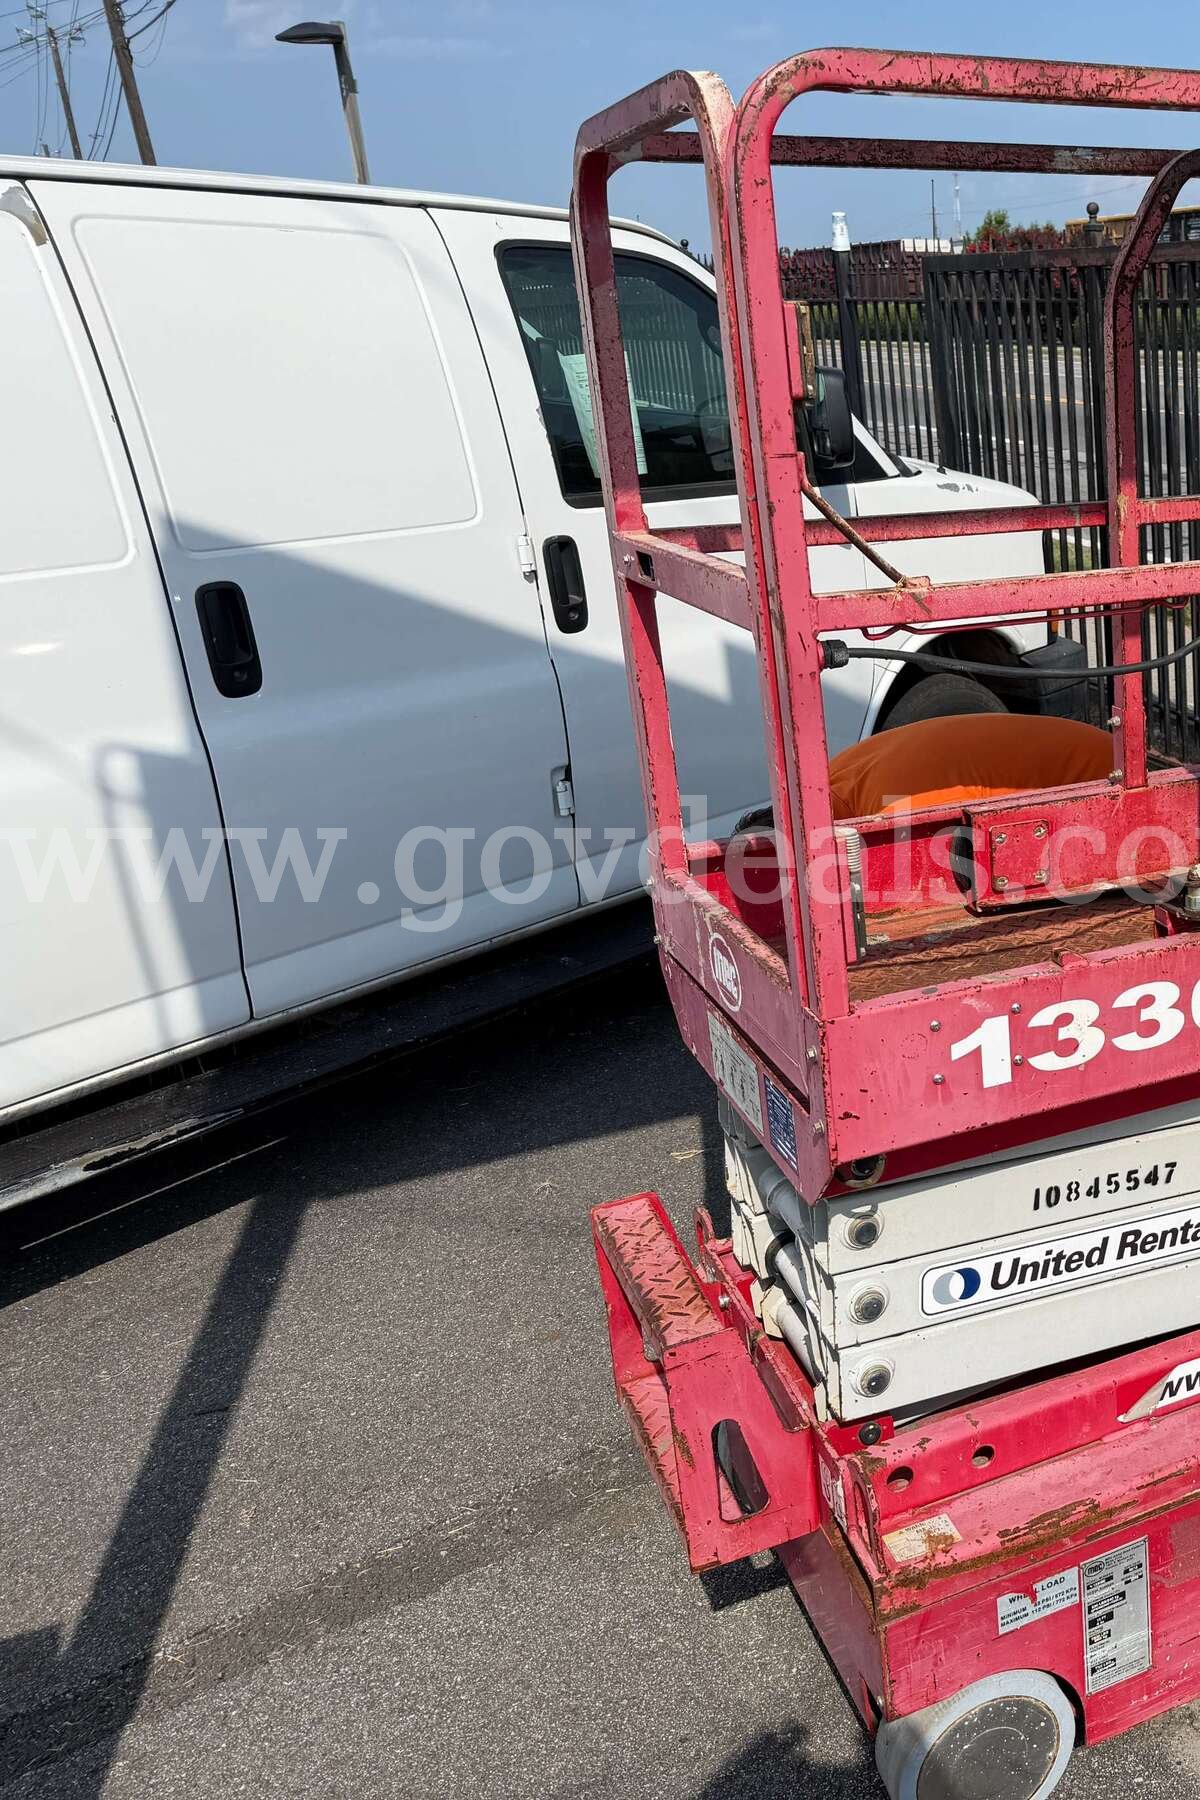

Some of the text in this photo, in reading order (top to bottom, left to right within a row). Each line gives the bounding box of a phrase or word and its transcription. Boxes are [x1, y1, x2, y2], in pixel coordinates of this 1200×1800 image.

[1032, 1161, 1178, 1211] 10845547
[990, 1236, 1110, 1291] United
[1041, 1576, 1066, 1592] LOAD
[1000, 1606, 1028, 1621] MINIMUM
[1000, 1612, 1029, 1628] MAXIMUM
